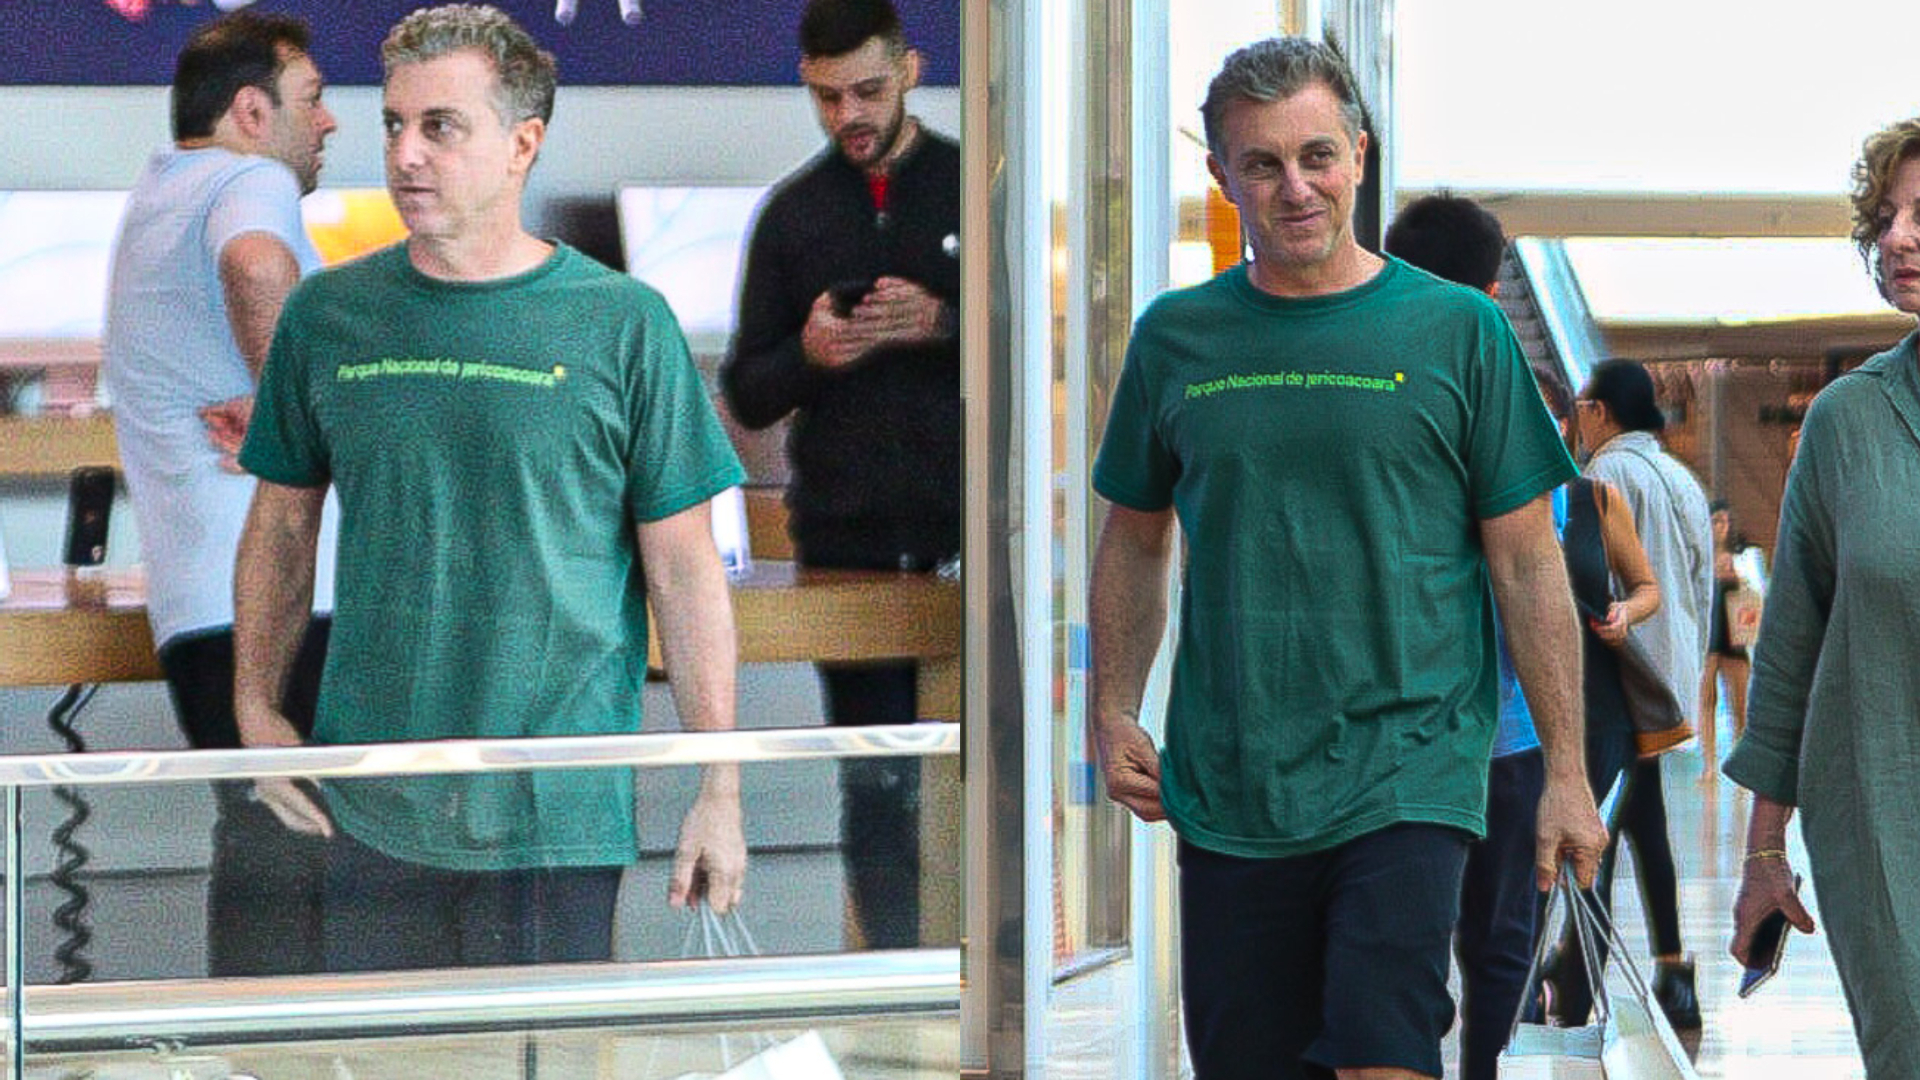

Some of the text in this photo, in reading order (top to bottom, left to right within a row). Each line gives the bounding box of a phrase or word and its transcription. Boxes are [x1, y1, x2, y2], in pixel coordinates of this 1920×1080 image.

[336, 363, 379, 382] Parque
[381, 357, 440, 375] Nacional
[440, 358, 460, 375] de
[1184, 379, 1226, 399] Parque
[1226, 371, 1285, 390] Nacional
[1286, 371, 1304, 386] de
